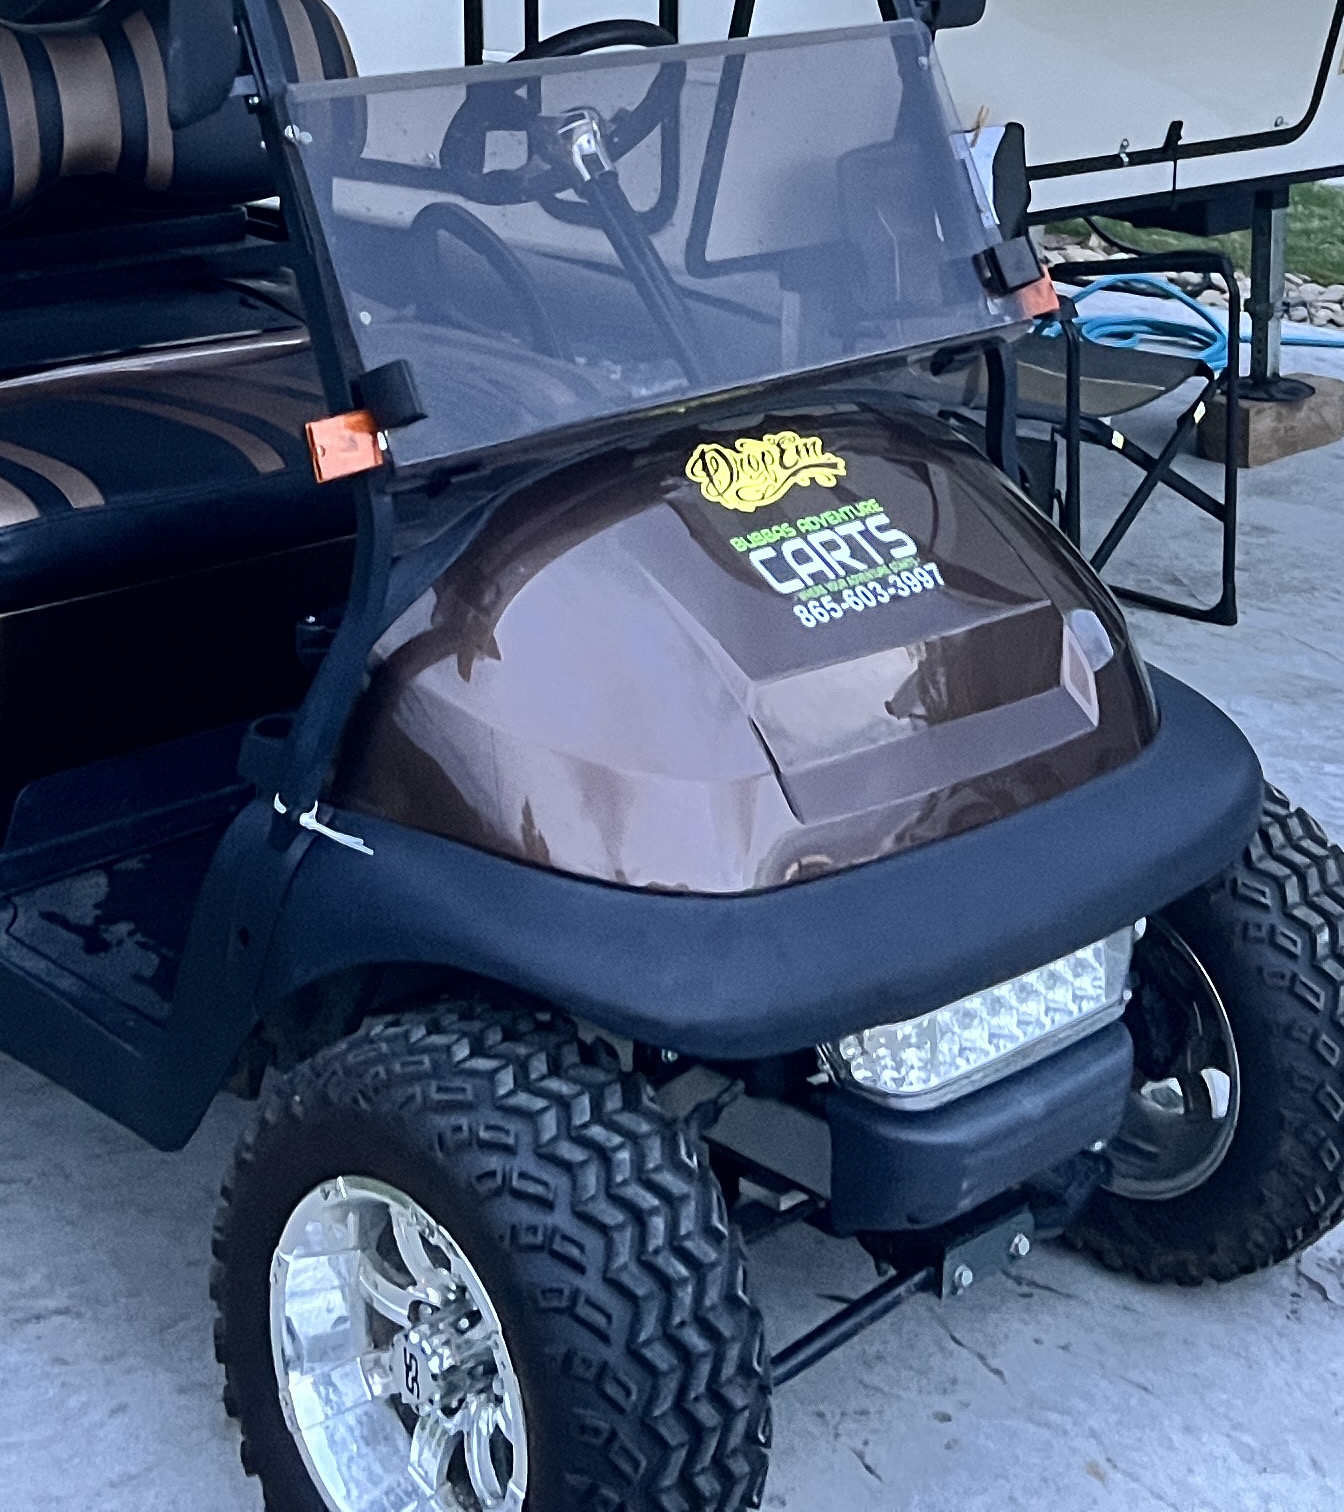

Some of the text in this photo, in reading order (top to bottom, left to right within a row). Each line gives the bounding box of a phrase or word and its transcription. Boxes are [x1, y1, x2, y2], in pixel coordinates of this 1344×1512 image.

[729, 498, 884, 552] BUBBAS ADVENTURE
[748, 512, 918, 594] CARTS
[793, 562, 945, 628] 865-603-3997
